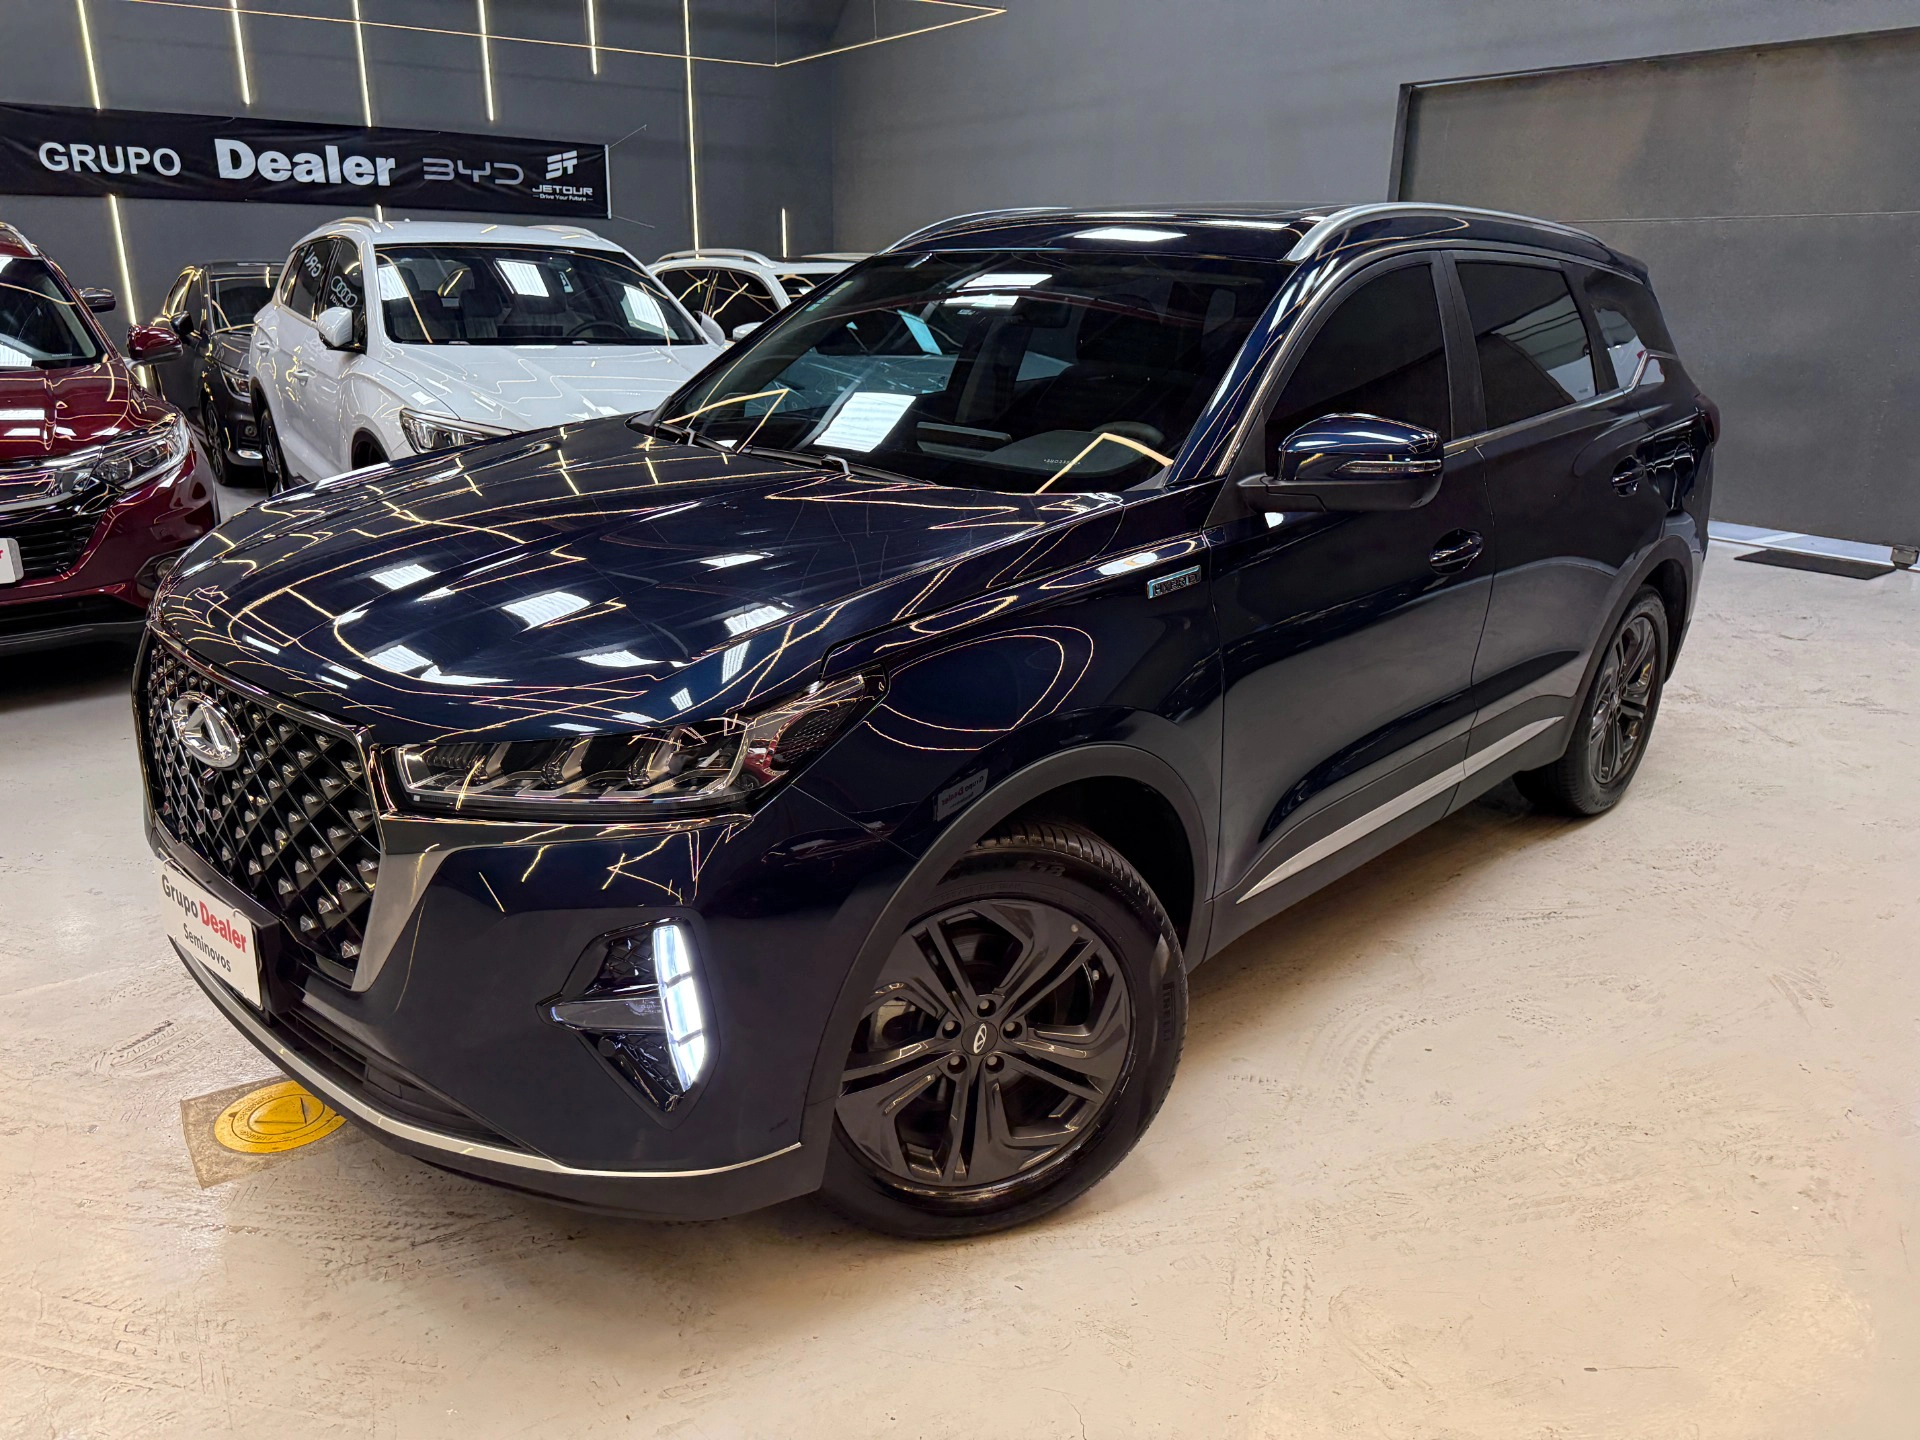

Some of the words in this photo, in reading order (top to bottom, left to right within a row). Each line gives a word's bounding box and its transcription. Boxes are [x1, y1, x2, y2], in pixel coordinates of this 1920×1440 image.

[38, 141, 182, 177] GRUPO
[214, 138, 396, 186] Dealer
[422, 157, 525, 186] BYD
[531, 184, 593, 196] JETOUR
[161, 874, 198, 918] Grupo
[199, 900, 247, 953] Dealer
[183, 922, 232, 973] Seminovos
